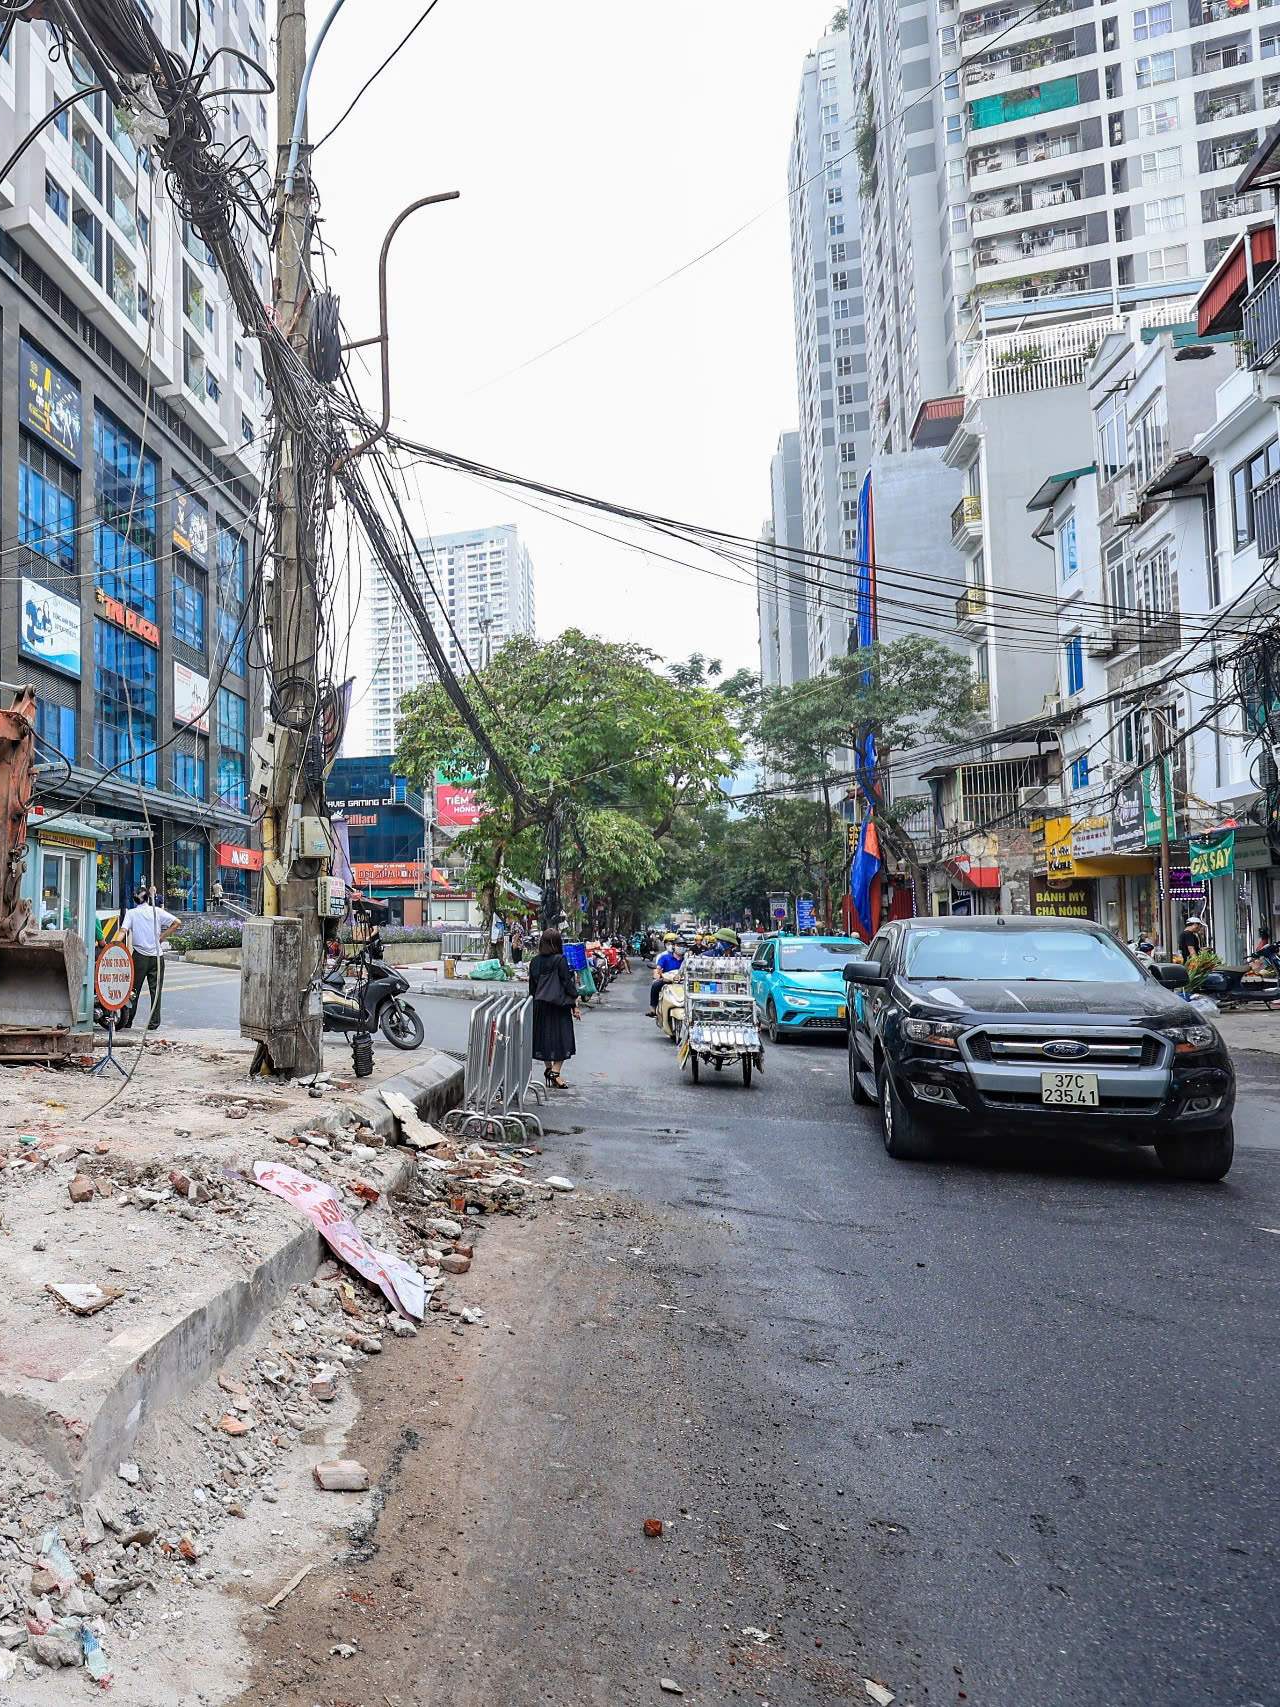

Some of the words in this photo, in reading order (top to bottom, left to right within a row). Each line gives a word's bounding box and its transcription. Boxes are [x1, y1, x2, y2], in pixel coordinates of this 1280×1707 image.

[125, 609, 160, 646] PLAZA
[347, 799, 380, 807] GAMING
[1036, 891, 1066, 902] BÁNH
[1035, 903, 1056, 916] CHẢ
[1058, 904, 1088, 916] NÓNG
[1053, 1044, 1079, 1054] Ford
[1055, 1074, 1085, 1089] 37C
[1043, 1089, 1095, 1105] 235.41
